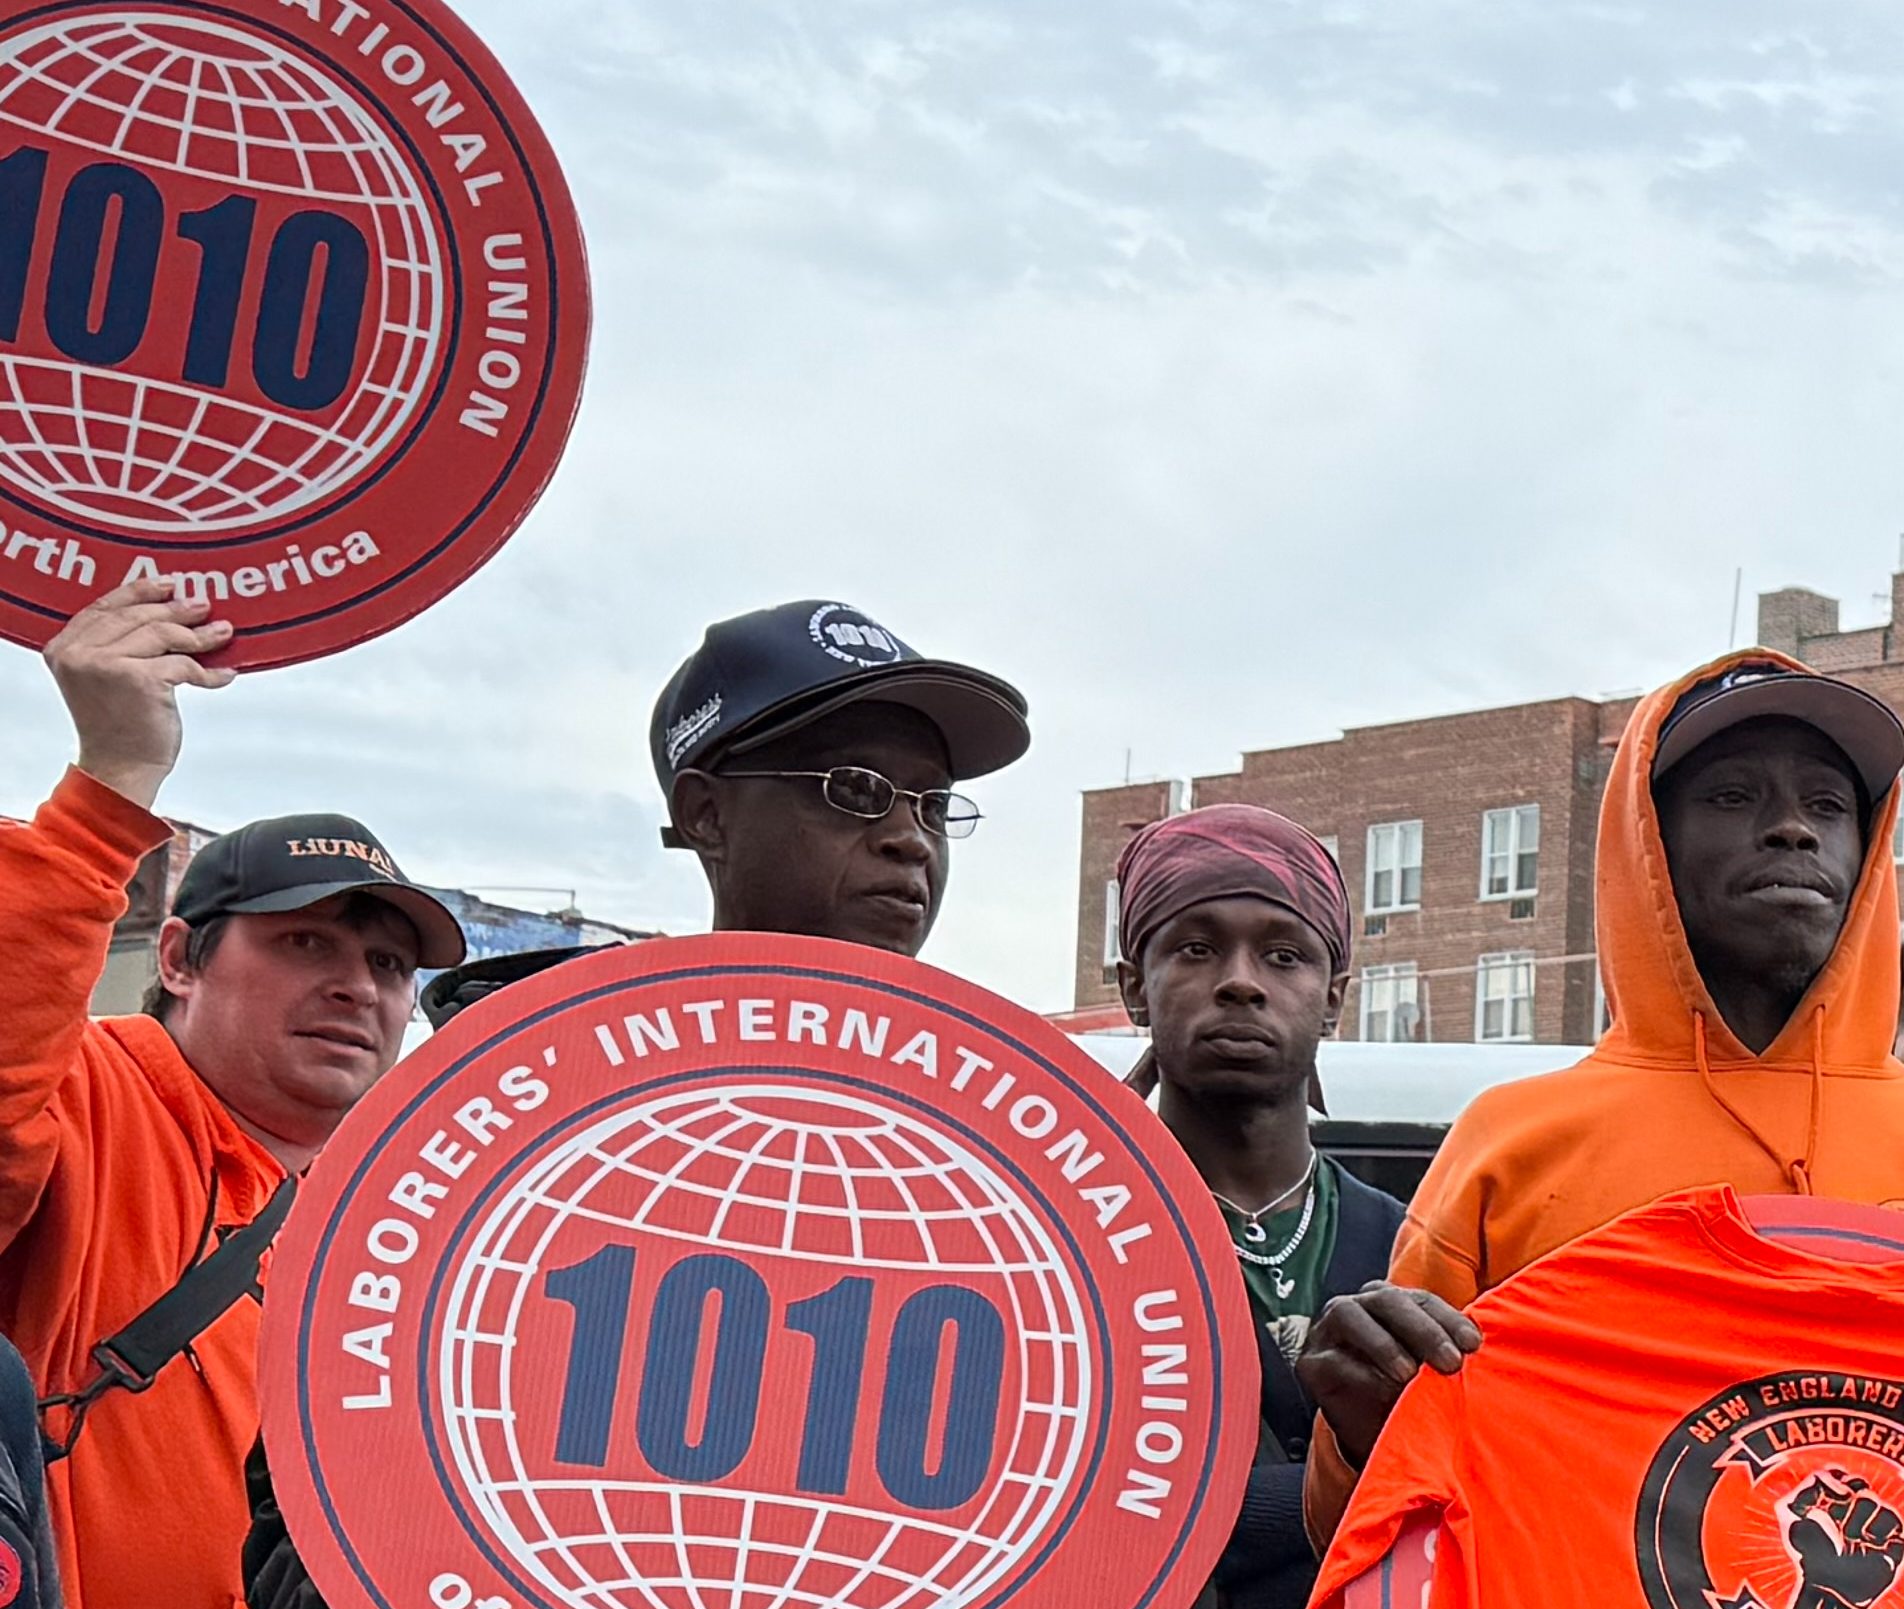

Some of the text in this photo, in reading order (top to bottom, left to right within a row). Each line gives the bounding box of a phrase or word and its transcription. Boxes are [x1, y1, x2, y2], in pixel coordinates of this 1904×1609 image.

[0, 145, 370, 411] 1010
[459, 232, 529, 439] UNION
[0, 519, 97, 587] rth
[543, 1242, 1006, 1512] 1010
[594, 997, 1155, 1266] INTERNATIONAL
[1116, 1289, 1189, 1521] UNION
[1688, 1394, 1751, 1445] NEW
[1759, 1376, 1903, 1409] ENGLAND
